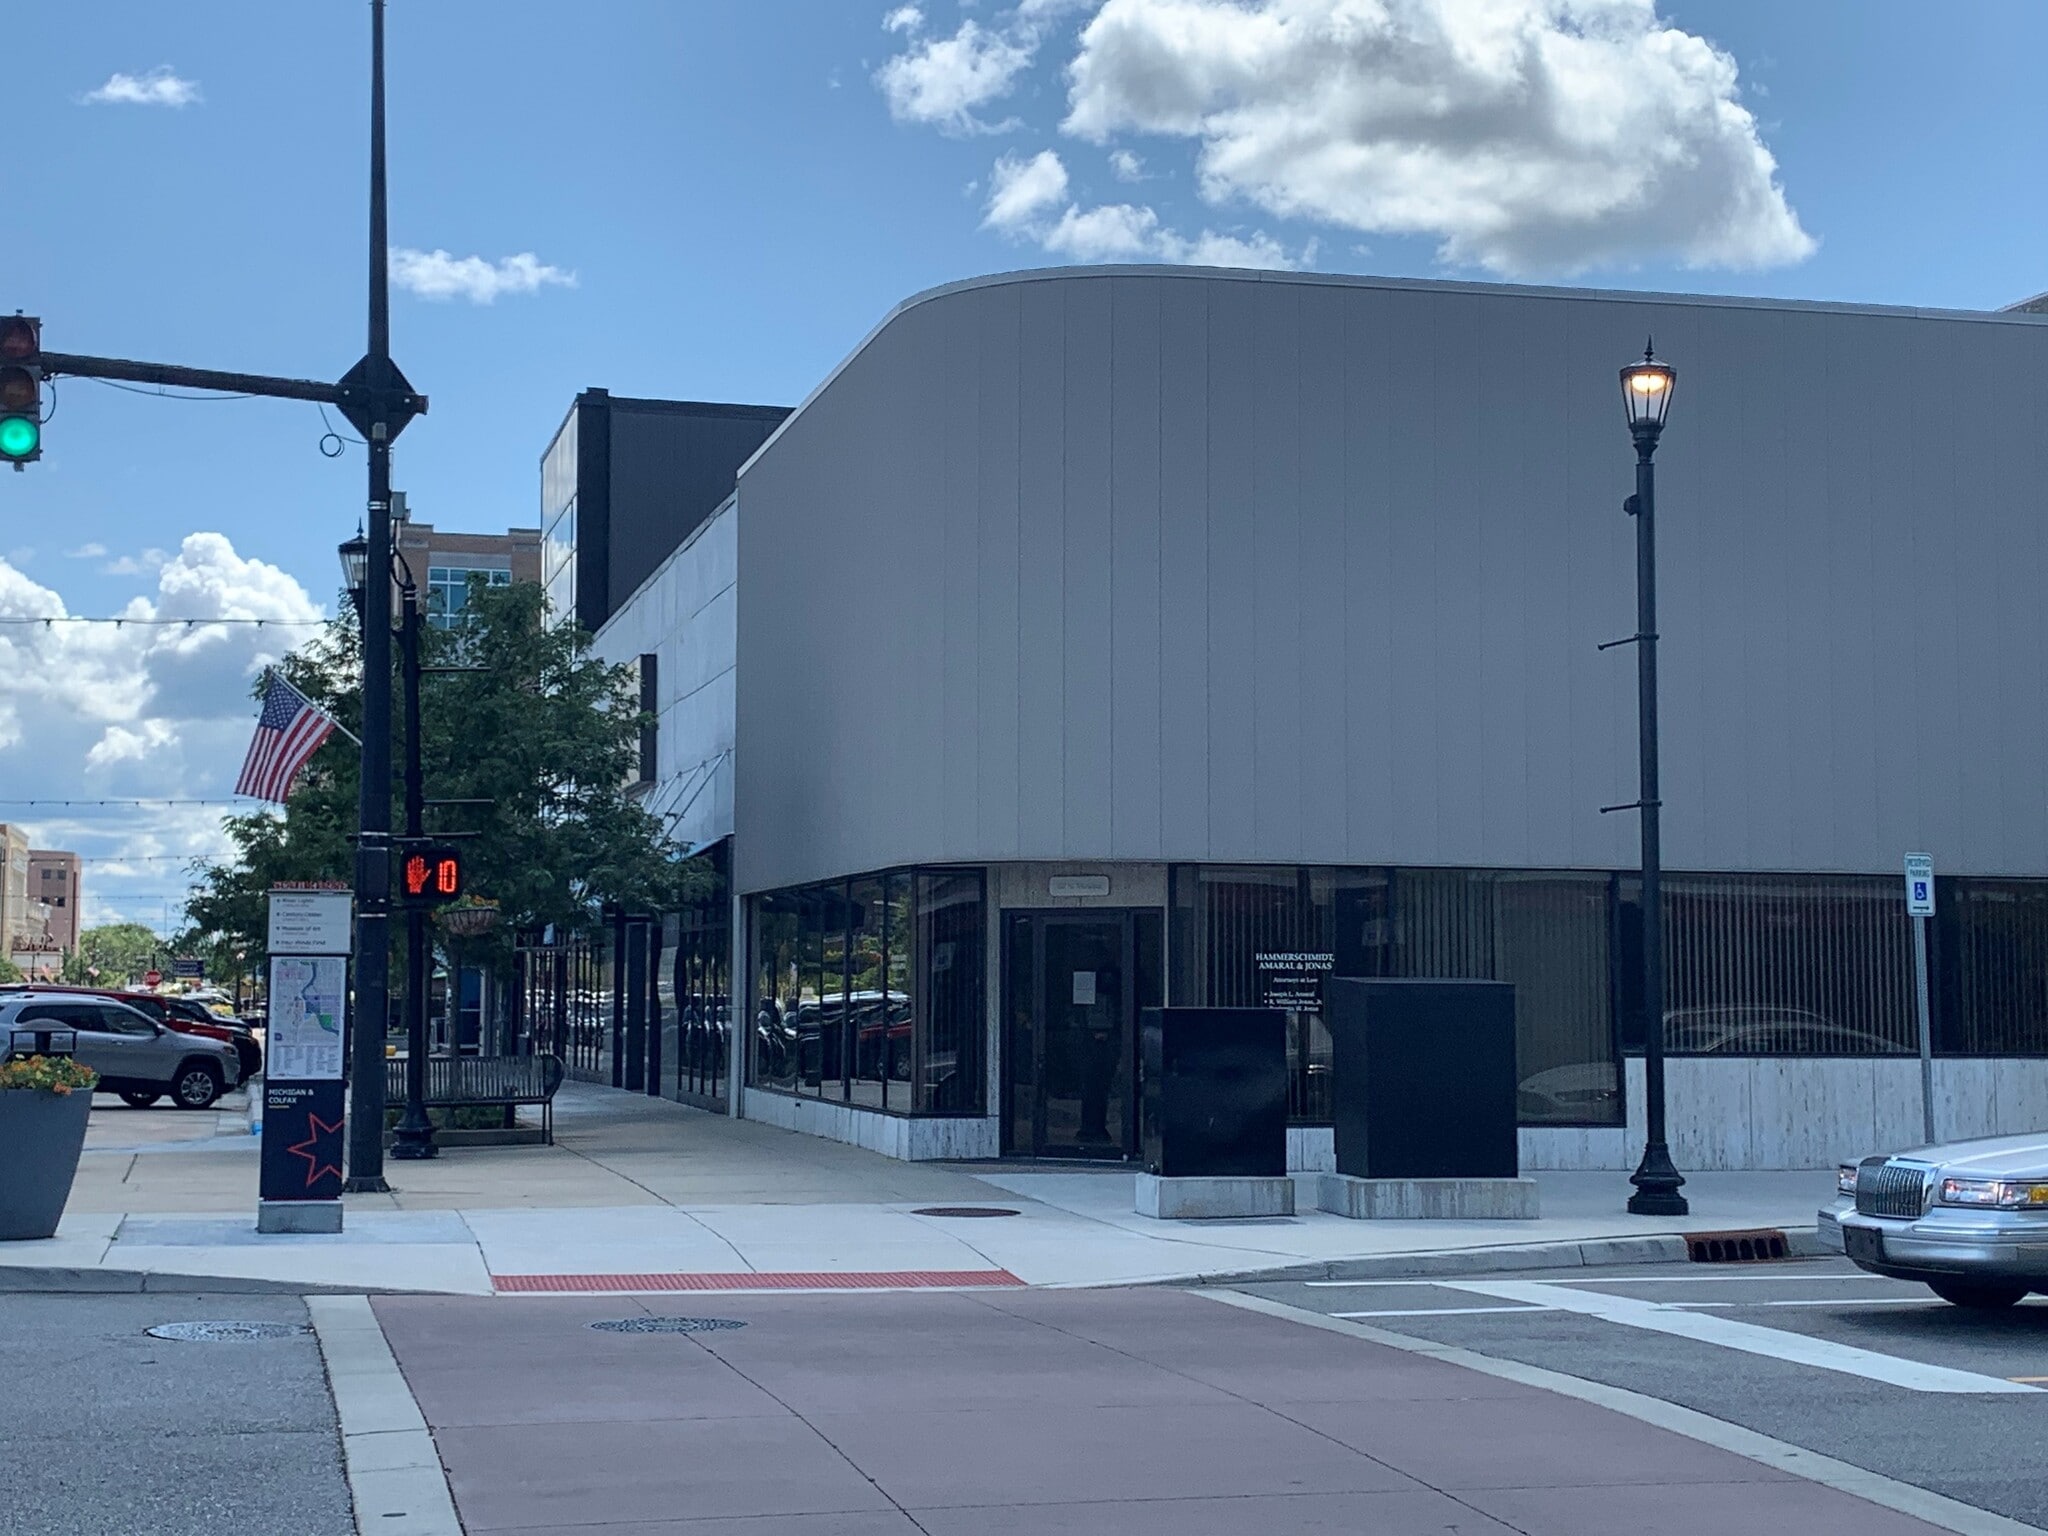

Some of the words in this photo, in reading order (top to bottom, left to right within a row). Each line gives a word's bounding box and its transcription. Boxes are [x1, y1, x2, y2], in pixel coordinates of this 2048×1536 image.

[438, 860, 456, 893] 10
[1909, 869, 1930, 878] PARKING
[1255, 953, 1335, 962] HAMMERSCHMIDT,
[1258, 962, 1296, 970] AMARAL
[1296, 962, 1304, 970] &
[1304, 962, 1333, 972] JONAS
